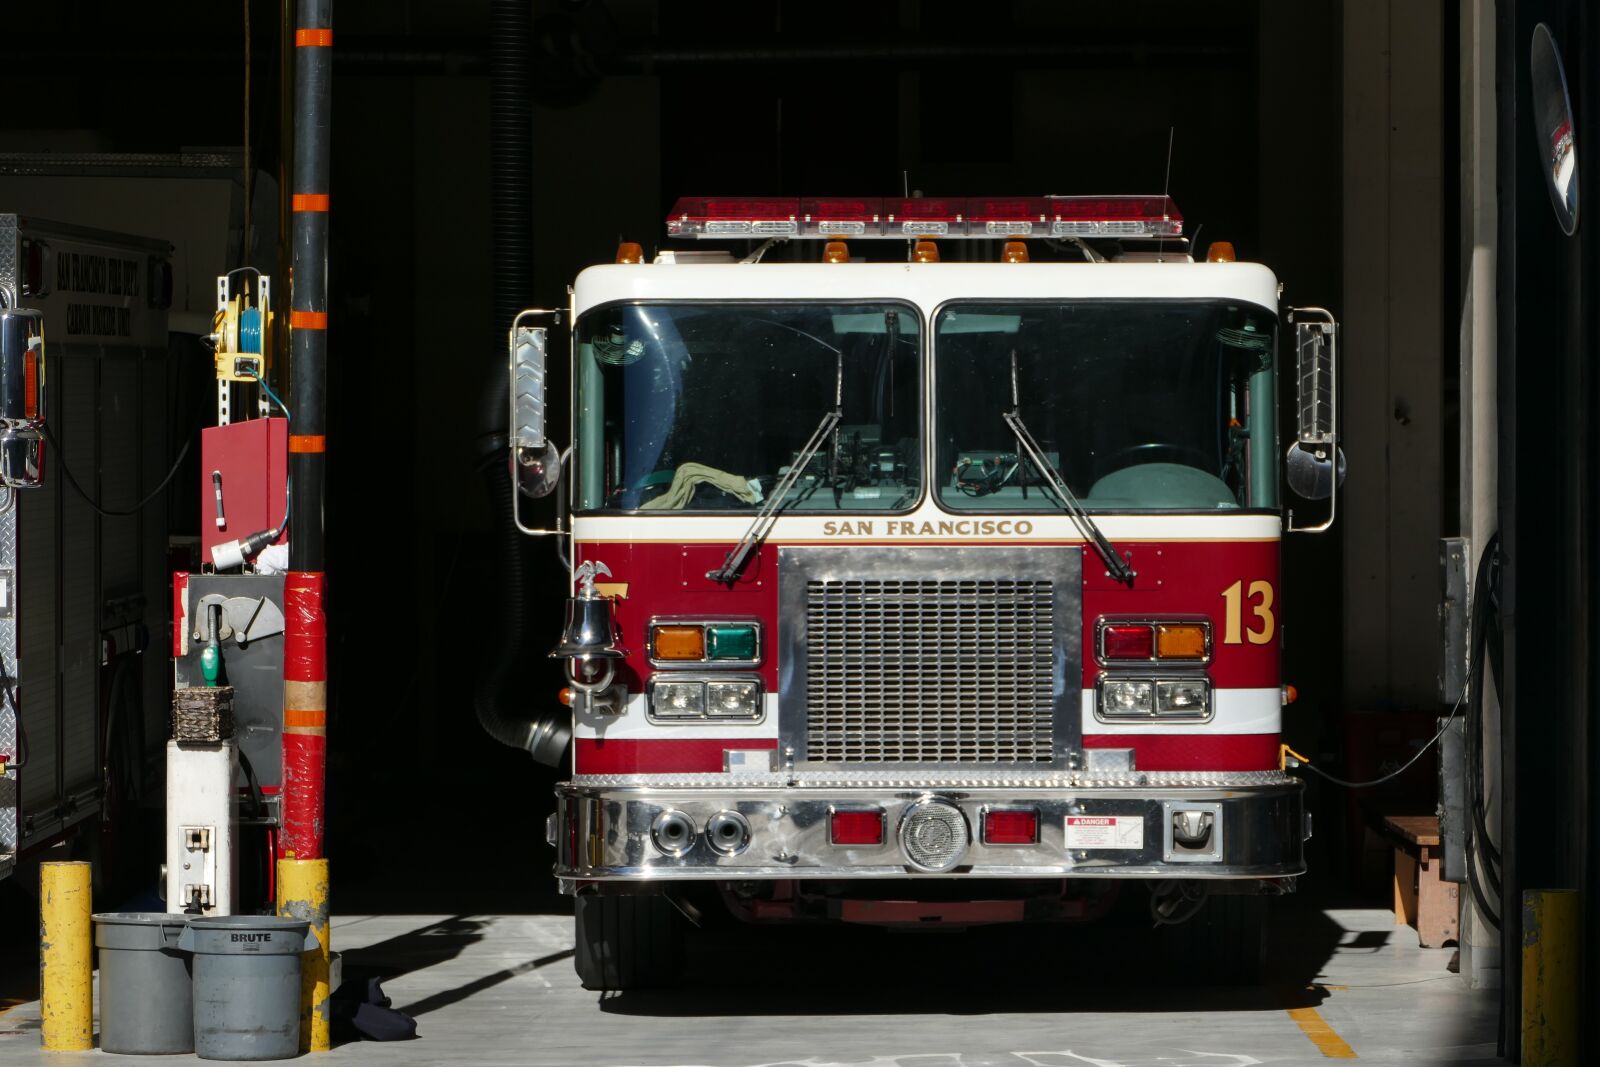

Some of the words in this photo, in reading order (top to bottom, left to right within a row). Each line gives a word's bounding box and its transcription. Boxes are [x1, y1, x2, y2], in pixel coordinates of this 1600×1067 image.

[57, 252, 71, 290] SAN
[72, 253, 106, 293] FRANCISCO
[67, 304, 91, 335] CARBON
[117, 307, 130, 337] UNIT
[823, 520, 873, 536] SAN
[886, 520, 1033, 536] FRANCISCO
[1221, 579, 1275, 645] 13
[231, 933, 272, 943] BRUTE
